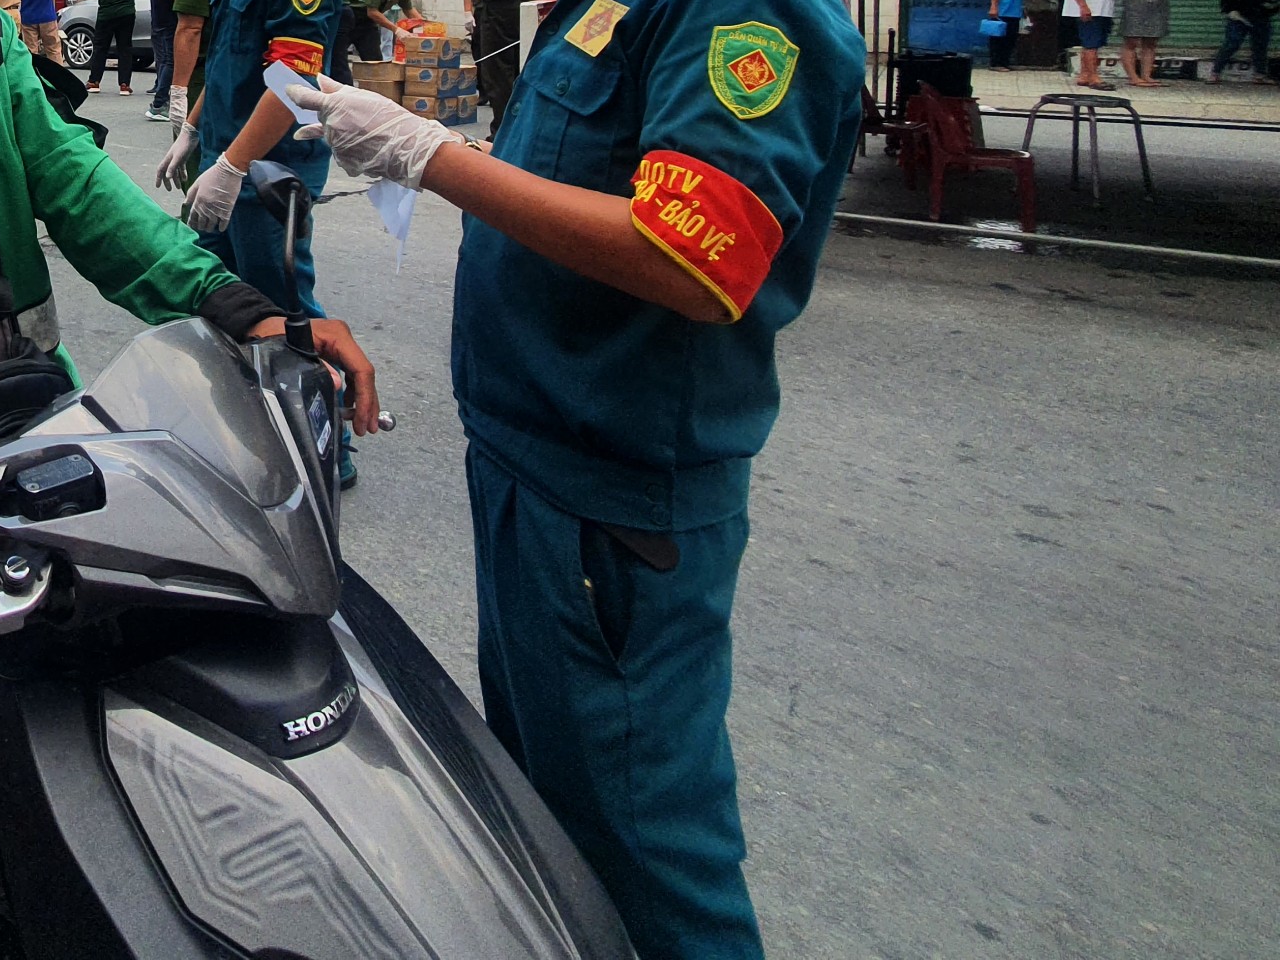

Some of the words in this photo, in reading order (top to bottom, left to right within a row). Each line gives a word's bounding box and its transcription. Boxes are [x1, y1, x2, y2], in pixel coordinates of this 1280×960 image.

[658, 199, 706, 238] BẢO
[700, 224, 737, 262] VỆ
[282, 682, 357, 741] HONDA
